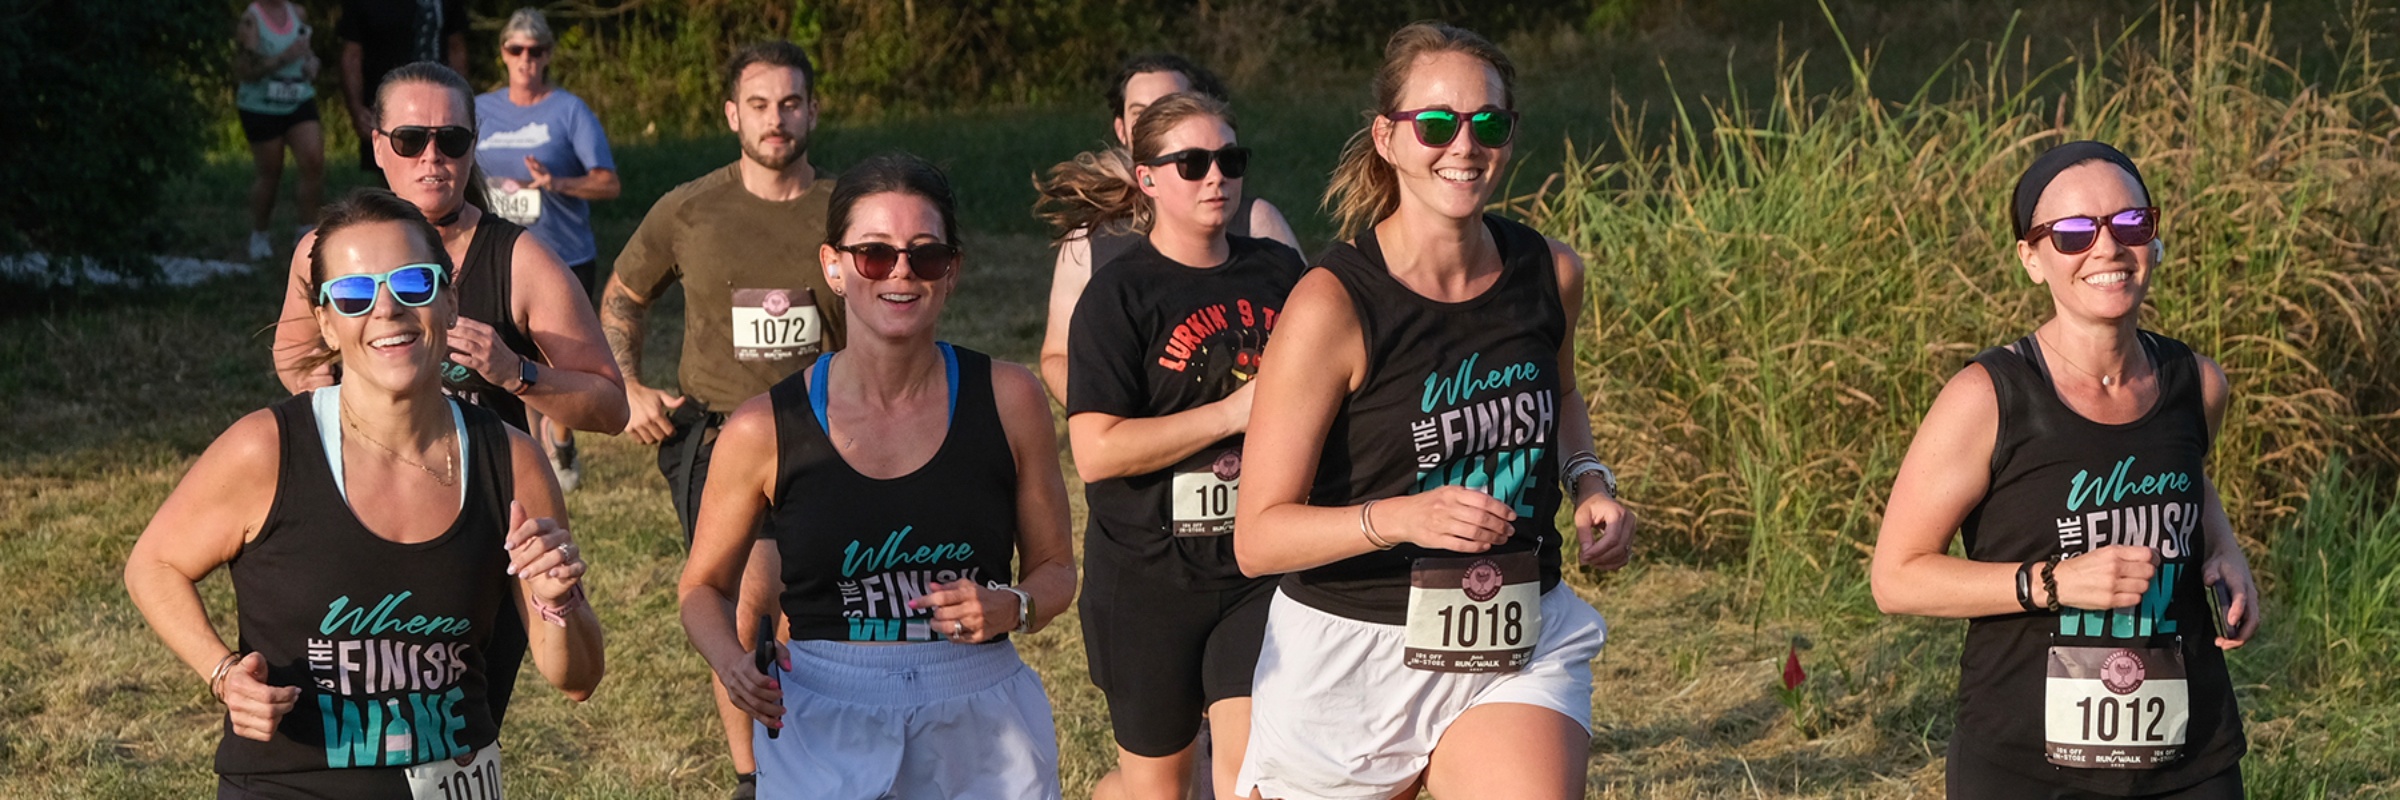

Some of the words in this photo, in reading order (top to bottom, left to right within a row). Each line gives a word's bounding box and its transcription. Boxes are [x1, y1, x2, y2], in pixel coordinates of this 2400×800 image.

[750, 317, 806, 344] 1072
[1158, 304, 1229, 372] LURKIN'
[1236, 298, 1255, 328] 9
[1421, 352, 1540, 414] Where
[1411, 416, 1439, 452] THE
[1440, 389, 1554, 462] FINISH
[1416, 452, 1442, 469] IS
[2066, 455, 2192, 512] Where
[841, 525, 975, 578] Where
[2056, 515, 2083, 549] THE
[2086, 502, 2199, 559] FINISH
[318, 590, 473, 636] Where
[837, 579, 863, 606] THE
[1438, 601, 1522, 648] 1018
[308, 638, 333, 671] THE
[2076, 696, 2166, 742] 1012
[438, 759, 500, 800] 1010
